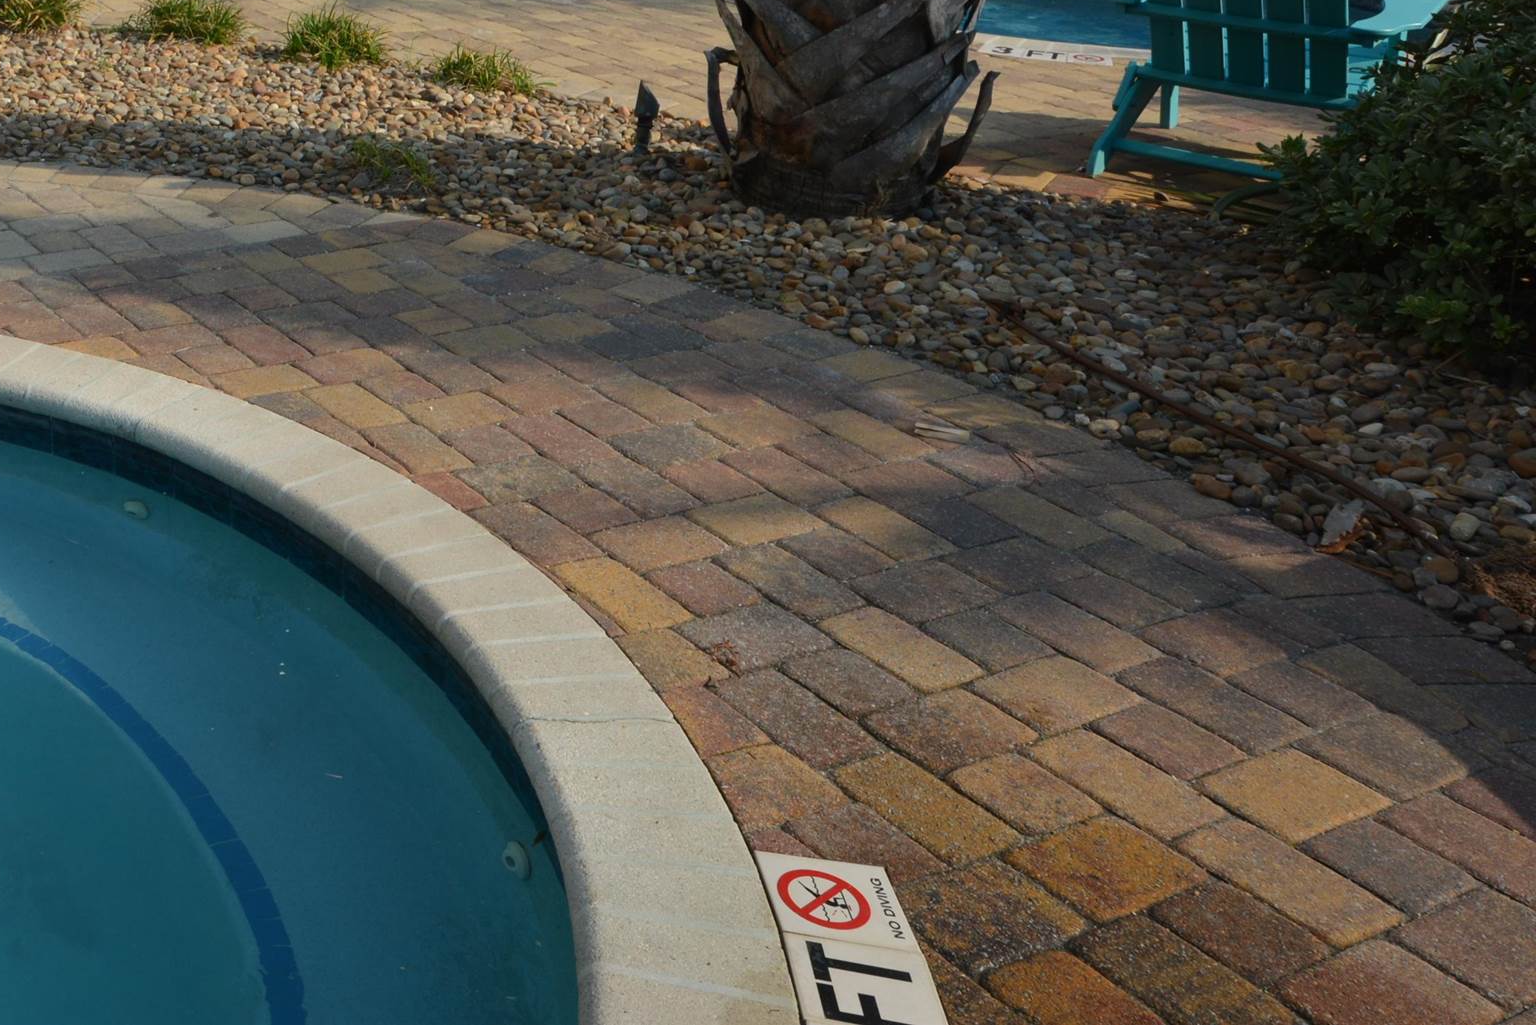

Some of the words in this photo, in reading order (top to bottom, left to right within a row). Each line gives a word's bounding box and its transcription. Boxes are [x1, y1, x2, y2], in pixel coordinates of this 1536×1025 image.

[992, 46, 1013, 54] 3
[1026, 50, 1064, 59] FT
[870, 878, 896, 917] DIVING
[888, 920, 906, 939] NO
[805, 940, 912, 1025] FT
